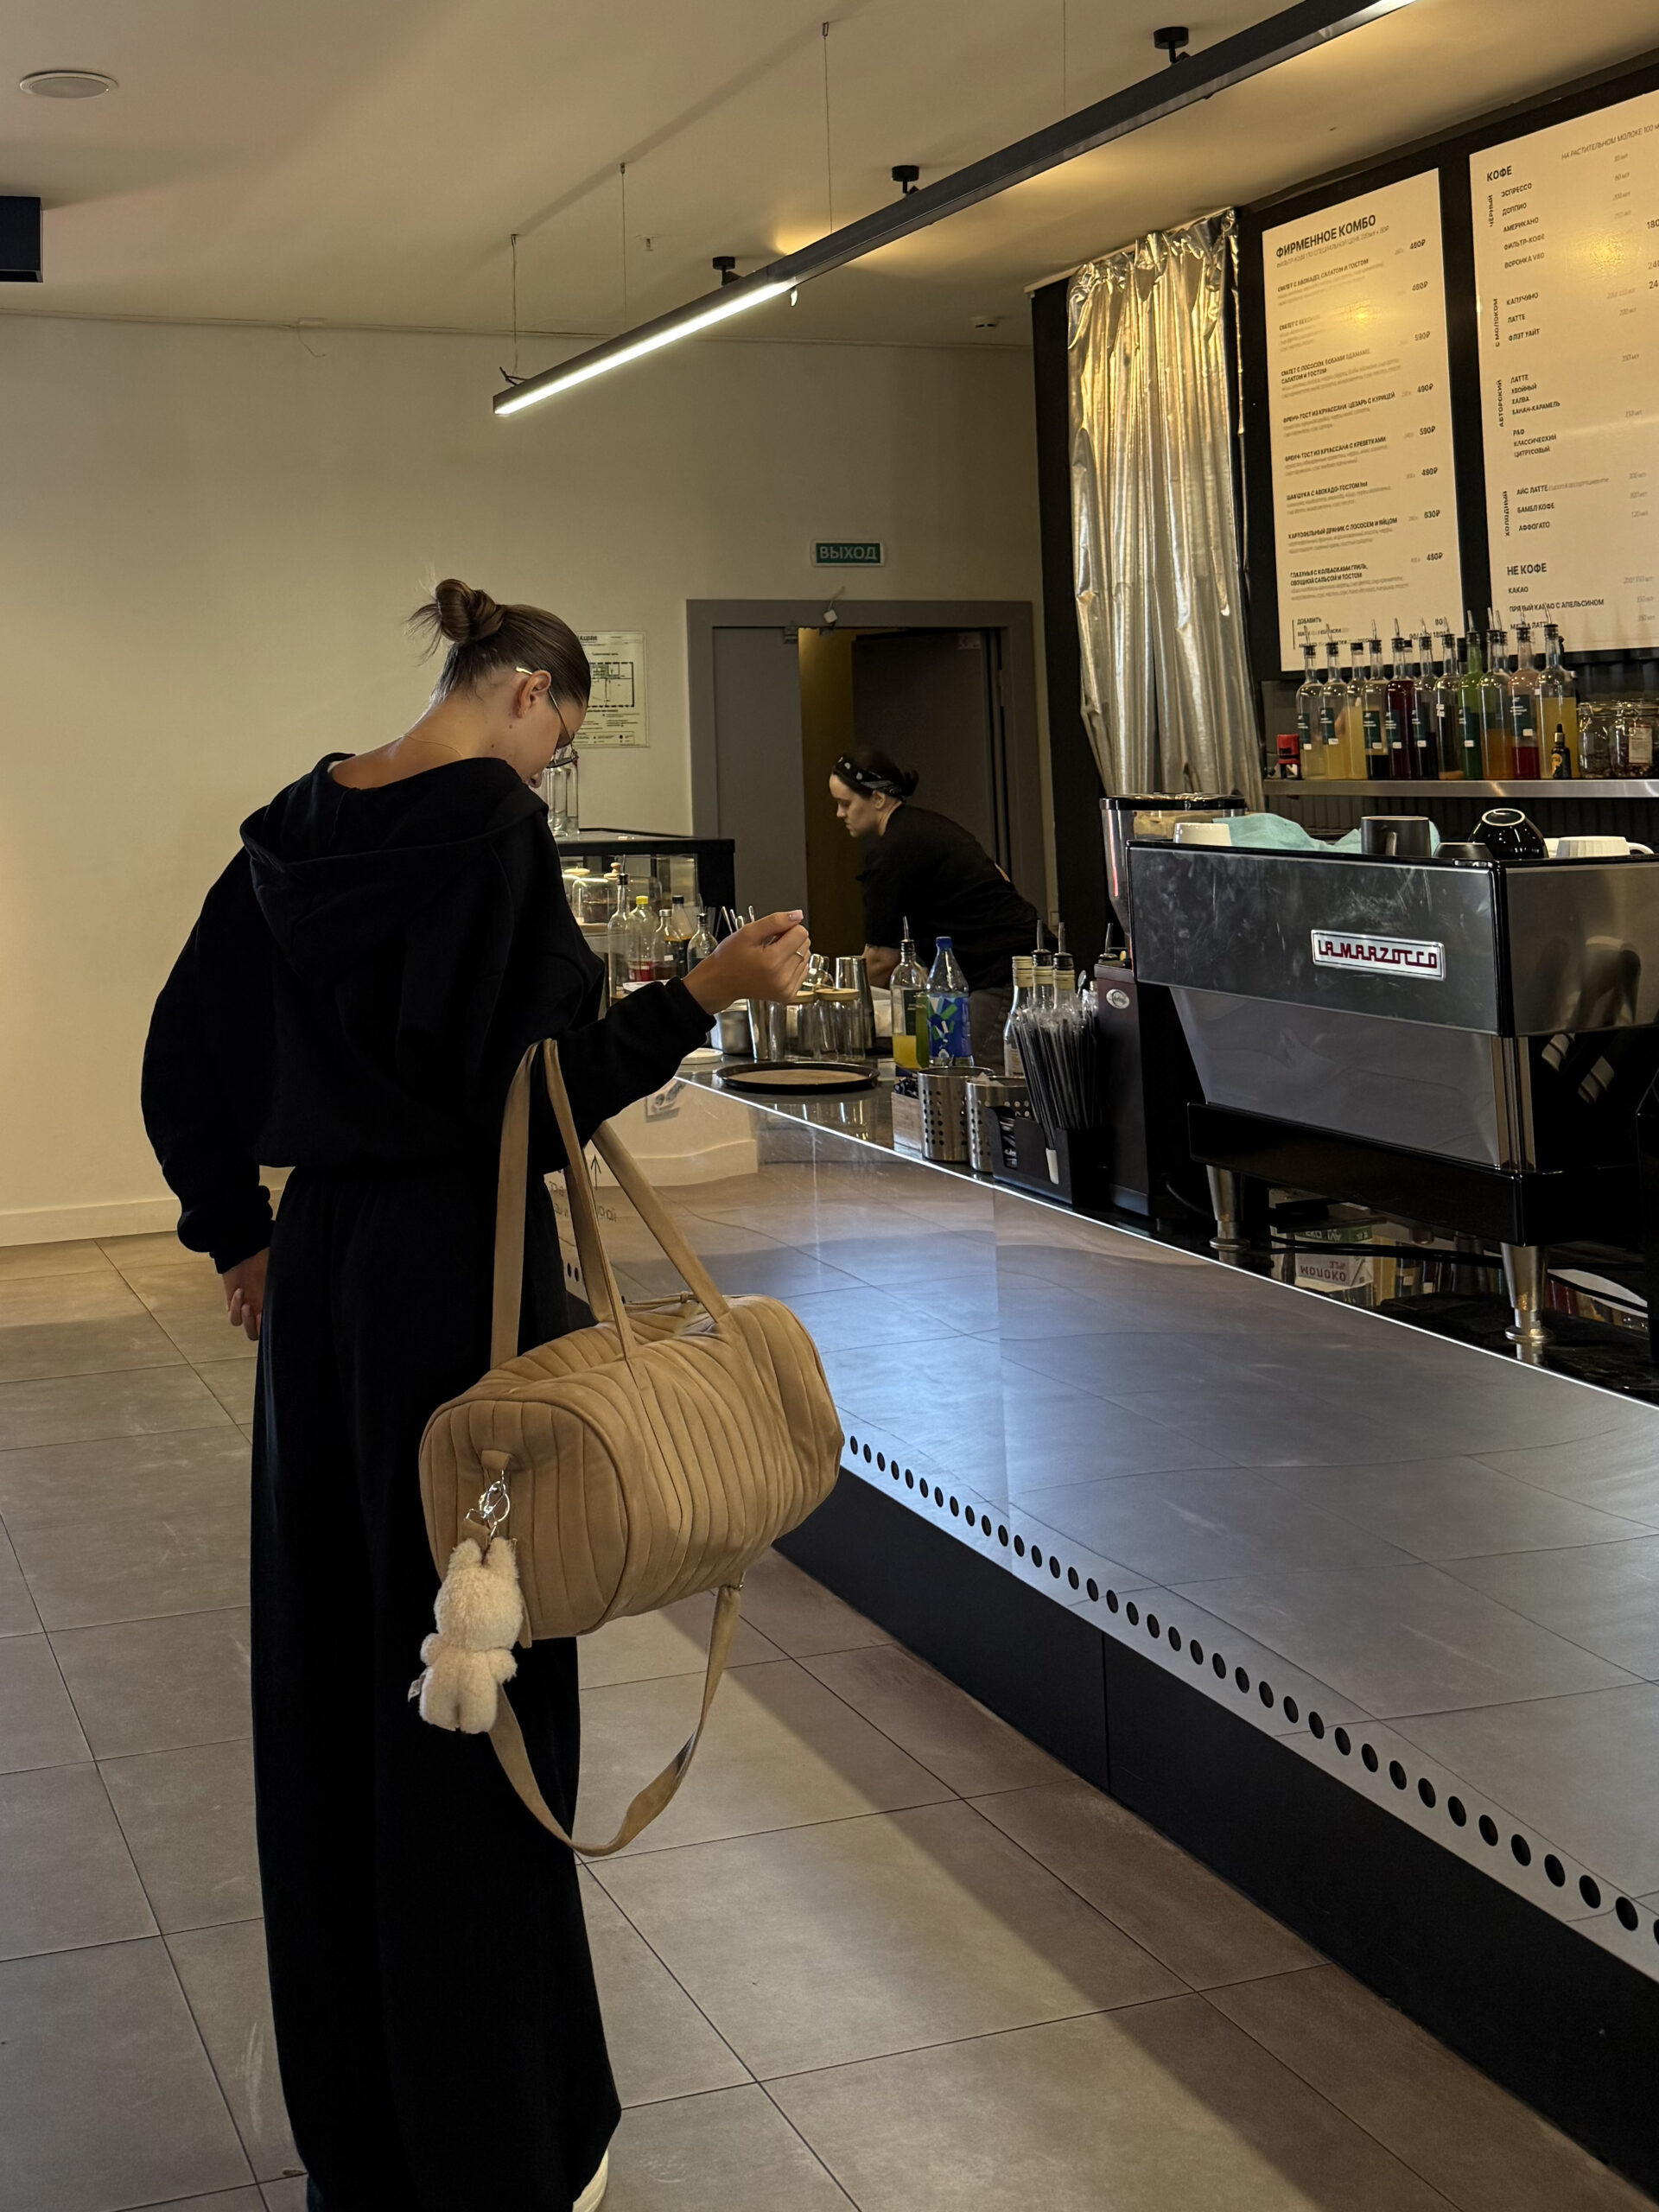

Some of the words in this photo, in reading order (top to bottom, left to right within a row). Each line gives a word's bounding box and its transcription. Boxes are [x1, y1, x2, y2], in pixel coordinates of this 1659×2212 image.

[1562, 151, 1569, 160] НА
[1571, 137, 1616, 156] РАСТИТЕЛЬНОМ
[1618, 129, 1643, 142] МОЛОКЕ
[1644, 124, 1653, 134] 100
[1487, 167, 1512, 181] КОФЕ
[1502, 183, 1532, 197] ЭСПРЕССО
[1503, 203, 1527, 215] ДОППИО
[1503, 218, 1539, 232] АМЕРИКАНО
[1276, 228, 1337, 258] ФИРМЕННОЕ
[1338, 214, 1376, 237] КОМБО
[1504, 234, 1545, 250] ФИЛЬТР-КОФЕ
[1505, 257, 1532, 268] ВОРОНКА
[1507, 293, 1538, 305] КАПУЧИНО
[1509, 314, 1525, 323] ЛАТТЕ
[1509, 332, 1523, 341] ФЛЭТ
[1526, 328, 1540, 338] УАЙТ
[1511, 374, 1528, 384] ЛАТТЕ
[1512, 385, 1536, 393] ХВОЙНЫЙ
[1513, 402, 1560, 415] БАНАН-КАРАМЕЛЬ
[1354, 435, 1386, 448] КРЕВЕТКАМИ
[1514, 435, 1556, 446] КЛАССИЧЕСКИЙ
[1515, 447, 1550, 457] ЦИТРУСОВЫЙ
[1530, 485, 1548, 493] ЛАТТЕ
[819, 546, 877, 560] ВЫХОД
[1508, 566, 1518, 575] НЕ
[1521, 563, 1547, 573] КОФЕ
